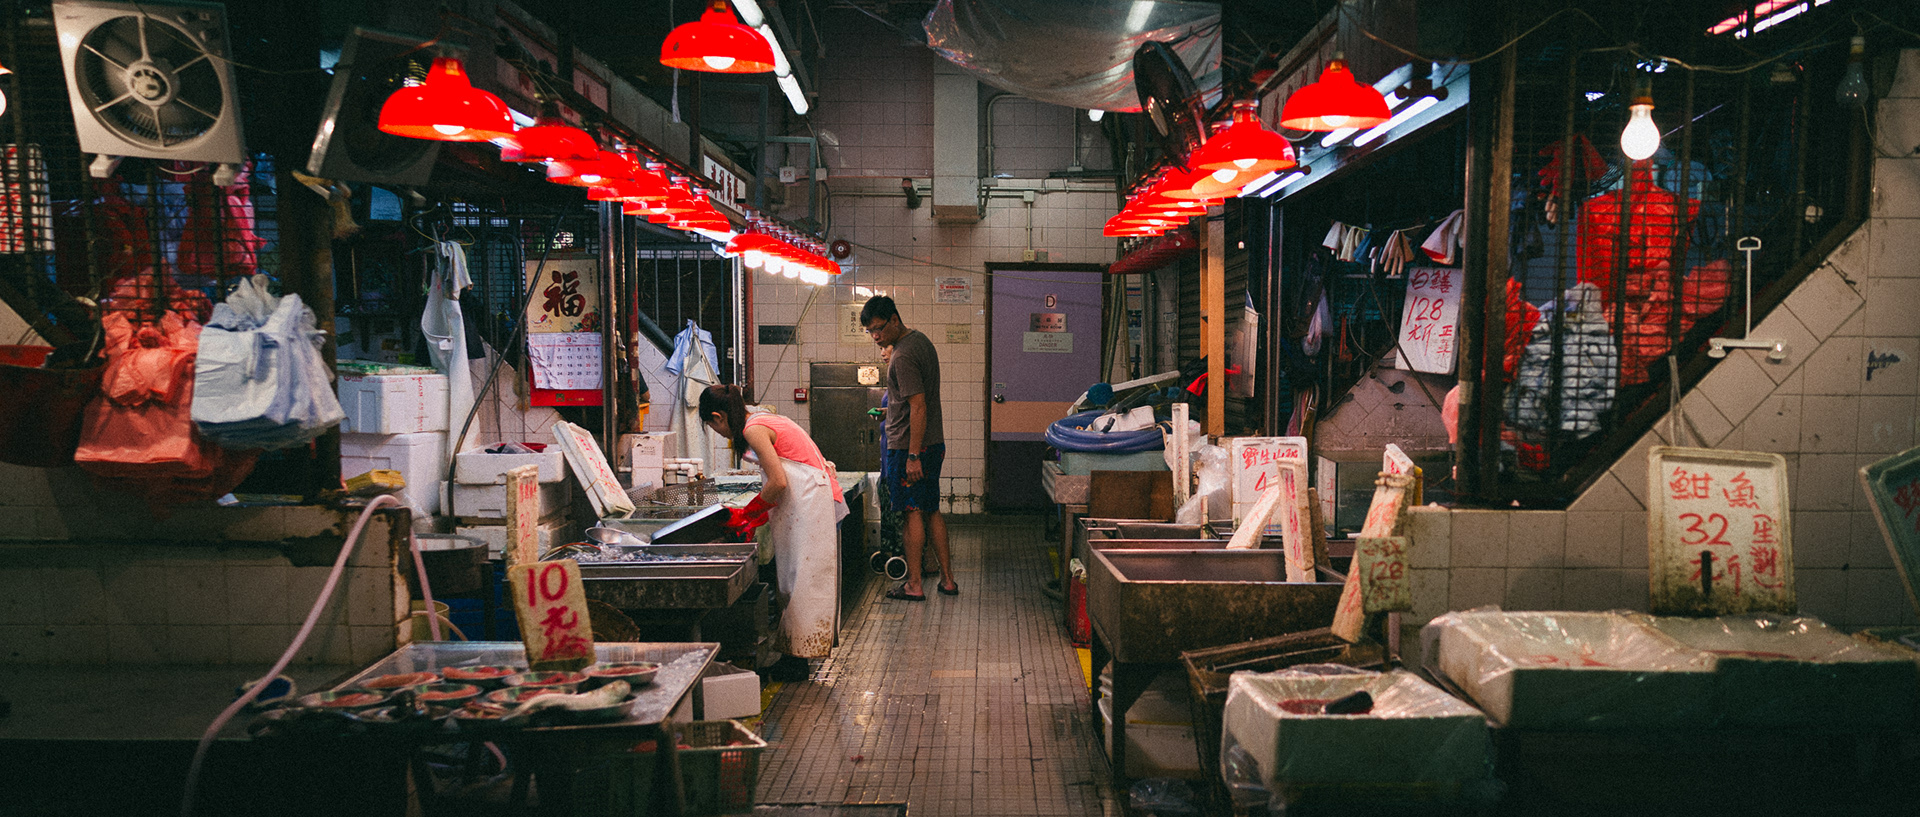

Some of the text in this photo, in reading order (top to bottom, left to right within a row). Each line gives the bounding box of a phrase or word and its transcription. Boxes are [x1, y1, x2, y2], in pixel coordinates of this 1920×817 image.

[543, 270, 586, 317] 福
[1046, 295, 1056, 308] D
[1406, 296, 1444, 326] 128
[1678, 512, 1732, 546] 32
[527, 562, 569, 608] 10
[1368, 560, 1405, 583] 128
